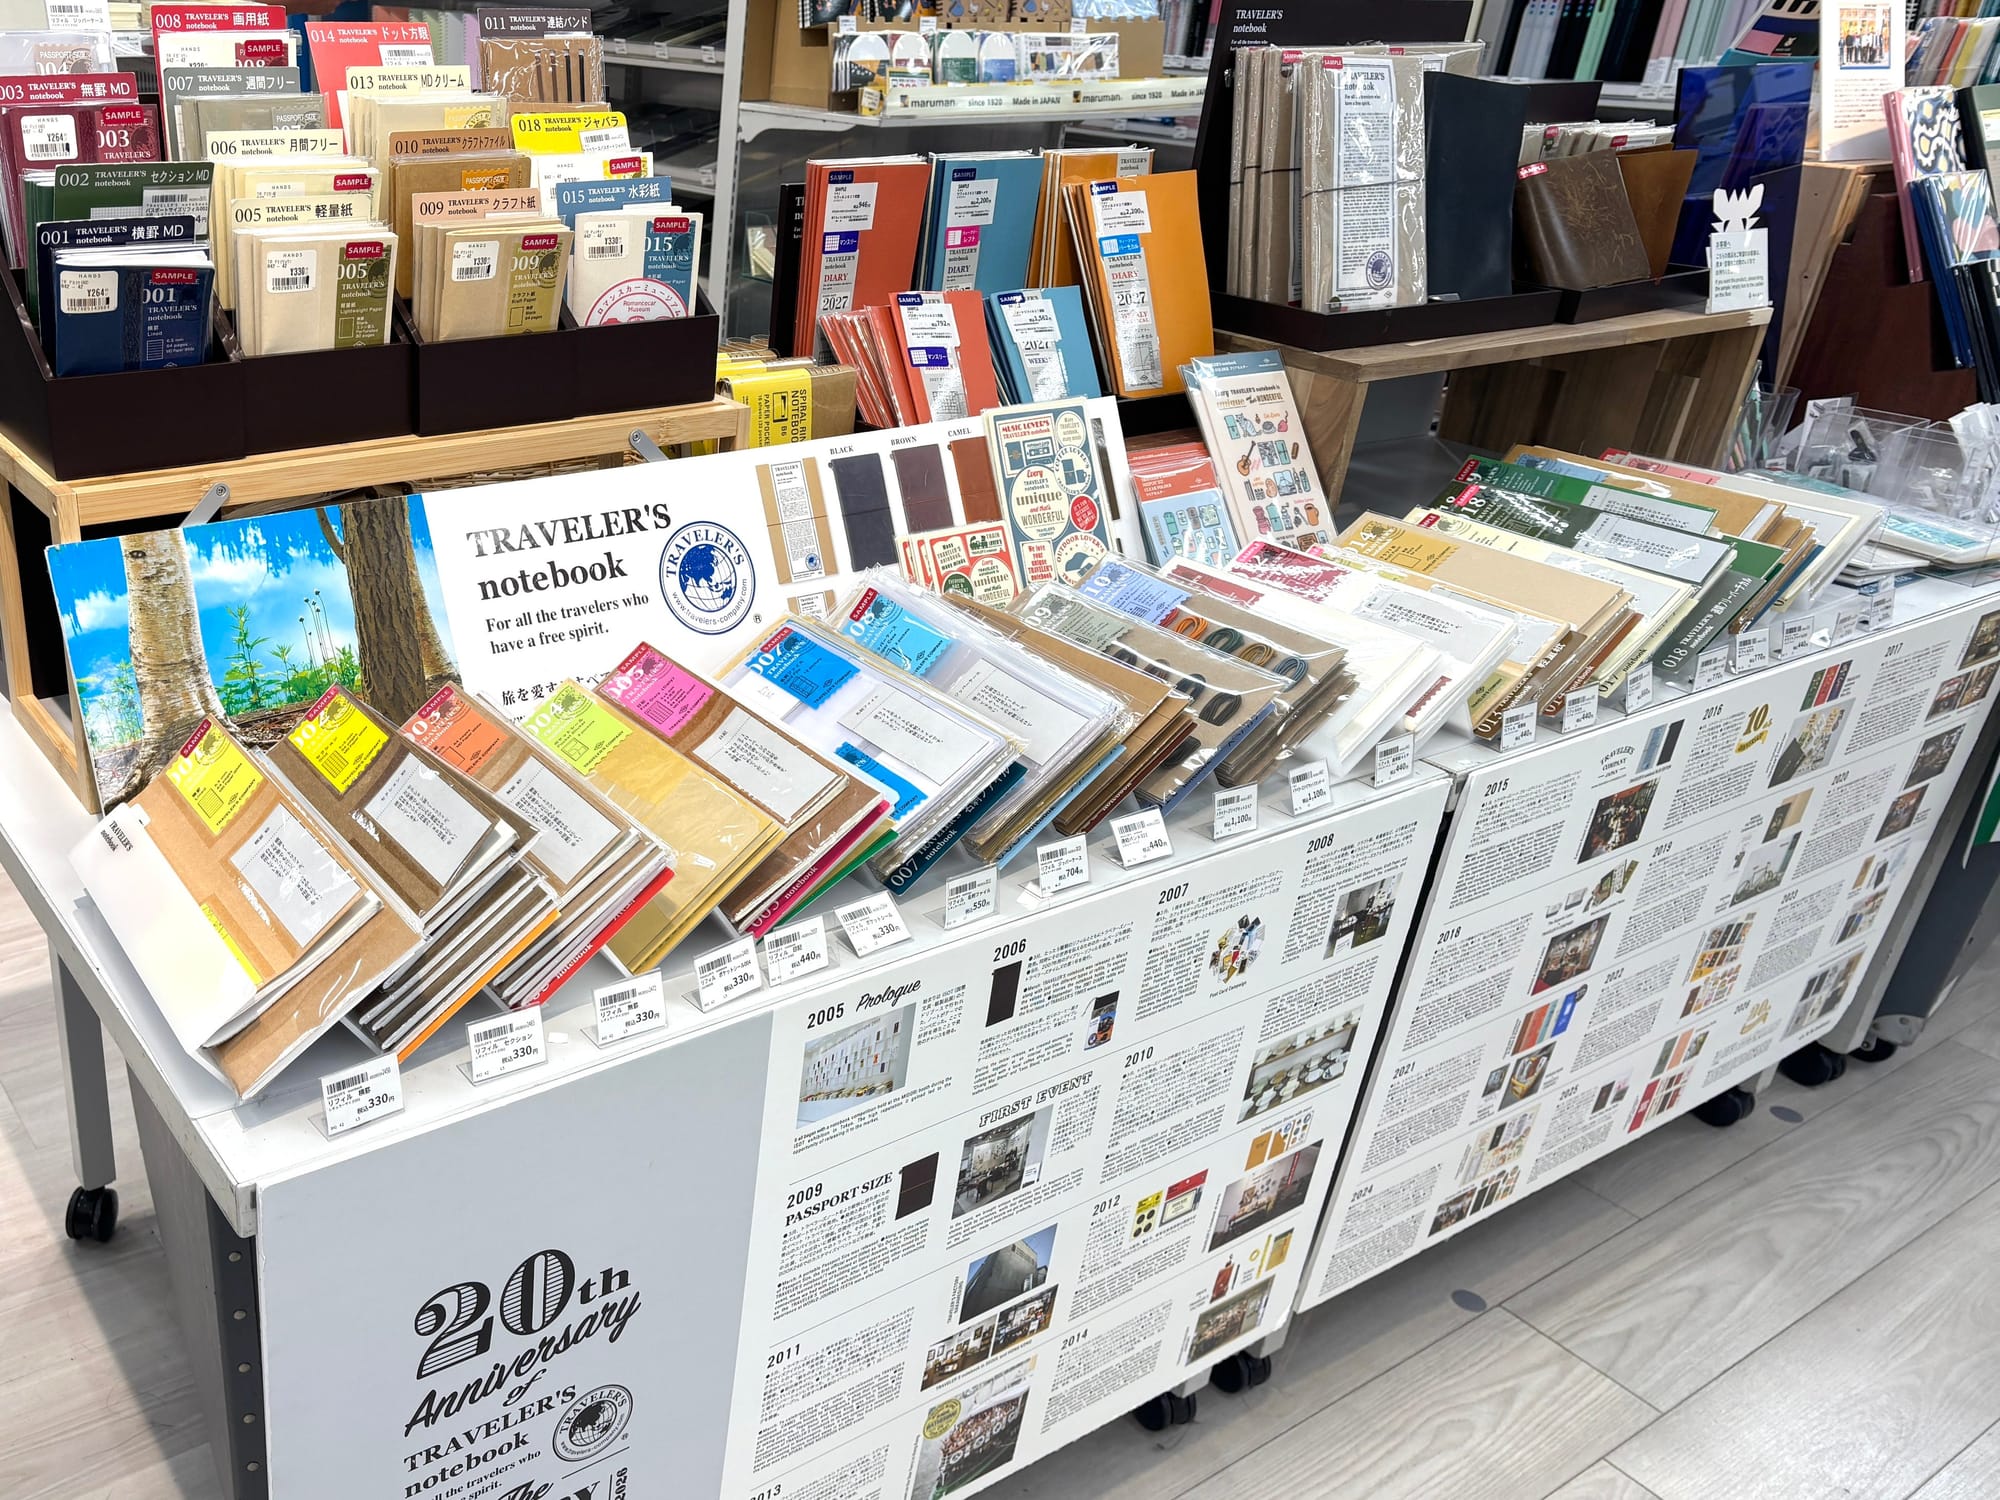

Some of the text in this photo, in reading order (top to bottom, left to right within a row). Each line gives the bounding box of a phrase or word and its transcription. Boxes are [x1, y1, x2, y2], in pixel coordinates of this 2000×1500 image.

[156, 12, 270, 29] 008 TRAVELER'S 画用紙
[484, 15, 588, 30] 011 TRAVELER'S 連結バンド
[1236, 10, 1283, 20] TRAVELER'S
[310, 26, 430, 43] 014 TRAVELER'S ドット方眼
[1233, 23, 1267, 33] notebook
[247, 44, 282, 54] SAMPLE
[28, 82, 76, 91] TRAVELER'S
[80, 83, 108, 98] 無罫
[110, 82, 130, 95] MD
[168, 74, 295, 91] 007 TRAVELER'S 週間フリー
[350, 76, 374, 90] 013
[377, 74, 418, 82] TRAVELER'S
[434, 75, 464, 88] クリーム
[911, 99, 955, 108] maruman
[105, 110, 141, 120] SAMPLE
[518, 116, 619, 132] 018 TRAVELER'S ジャバラ
[211, 138, 338, 155] 006 TRAVELER'S 月間フリー
[395, 134, 506, 154] 010 TRAVELER'S クラフトファイル
[610, 160, 641, 171] SAMPLE
[60, 170, 210, 187] 002 TRAVELER'S セクション MD
[336, 177, 369, 187] SAMPLE
[563, 182, 661, 204] 015 TRAVELER'S 水彩紙
[235, 203, 353, 223] 005 TRAVELER'S 軽量紙
[419, 196, 536, 216] 009 TRAVELER'S クラフト紙
[41, 225, 184, 245] 001 TRAVELER'S 横罫 MD
[825, 256, 856, 264] TRAVELER'S
[948, 264, 971, 274] DIARY
[824, 273, 848, 282] DIARY
[1112, 271, 1139, 280] DIARY
[822, 296, 849, 311] 2027
[890, 436, 918, 446] BROWN
[947, 428, 972, 436] CAMEL
[830, 445, 854, 455] BLACK
[1458, 461, 1476, 481] SAMPLE
[1016, 491, 1063, 506] unique
[1457, 485, 1477, 504] SAMPLE
[1021, 512, 1065, 526] WONDERFUL
[466, 504, 672, 557] TRAVELER'S
[666, 528, 746, 578] TRAVELER'S
[478, 551, 628, 600] notebook
[1028, 565, 1053, 573] TRAVELER'S
[1031, 573, 1052, 581] notebook
[974, 573, 1009, 587] unique
[486, 593, 649, 633] For all the travelers who
[853, 591, 874, 620] SAMPLE
[490, 622, 609, 654] have a free spirit.
[764, 629, 789, 651] SAMPLE
[1662, 648, 1688, 668] 018
[1680, 614, 1714, 645] TRAVELER'S
[621, 646, 646, 670] SAMPLE
[1884, 642, 1904, 657] 2017
[308, 689, 336, 720] SAMPLE
[421, 690, 451, 715] SAMPLE
[1702, 704, 1724, 721] 2016
[182, 720, 210, 756] SAMPLE
[1484, 778, 1509, 797] 2015
[100, 829, 118, 852] notebook
[108, 820, 134, 852] TRAVELER'S
[925, 829, 958, 860] notebook
[1306, 833, 1334, 854] 2008
[1652, 841, 1673, 858] 2019
[784, 866, 818, 900] notebook
[1158, 883, 1189, 905] 2007
[1437, 926, 1462, 945] 2018
[994, 938, 1026, 962] 2006
[555, 943, 593, 979] notebook
[600, 1008, 622, 1018] リフィル
[807, 978, 921, 1029] 2005 Prologue
[475, 1033, 533, 1056] リフィル セクション
[1125, 1046, 1154, 1068] 2010
[1393, 1063, 1415, 1080] 2021
[328, 1093, 353, 1107] リフィル
[979, 1098, 1031, 1127] FIRST
[1036, 1072, 1093, 1104] EVENT
[784, 1172, 893, 1227] PASSPORT SIZE
[787, 1183, 823, 1209] 2009
[1093, 1195, 1121, 1215] 2012
[415, 1249, 631, 1380] 20th
[1062, 1329, 1088, 1350] 2014
[404, 1291, 642, 1437] Anniversary
[767, 1344, 801, 1369] 2011
[502, 1368, 547, 1407] of
[560, 1388, 628, 1434] TRAVELER'S
[404, 1385, 577, 1472] TRAVELER'S
[404, 1432, 530, 1499] notebook
[446, 1450, 541, 1498] the travelers who
